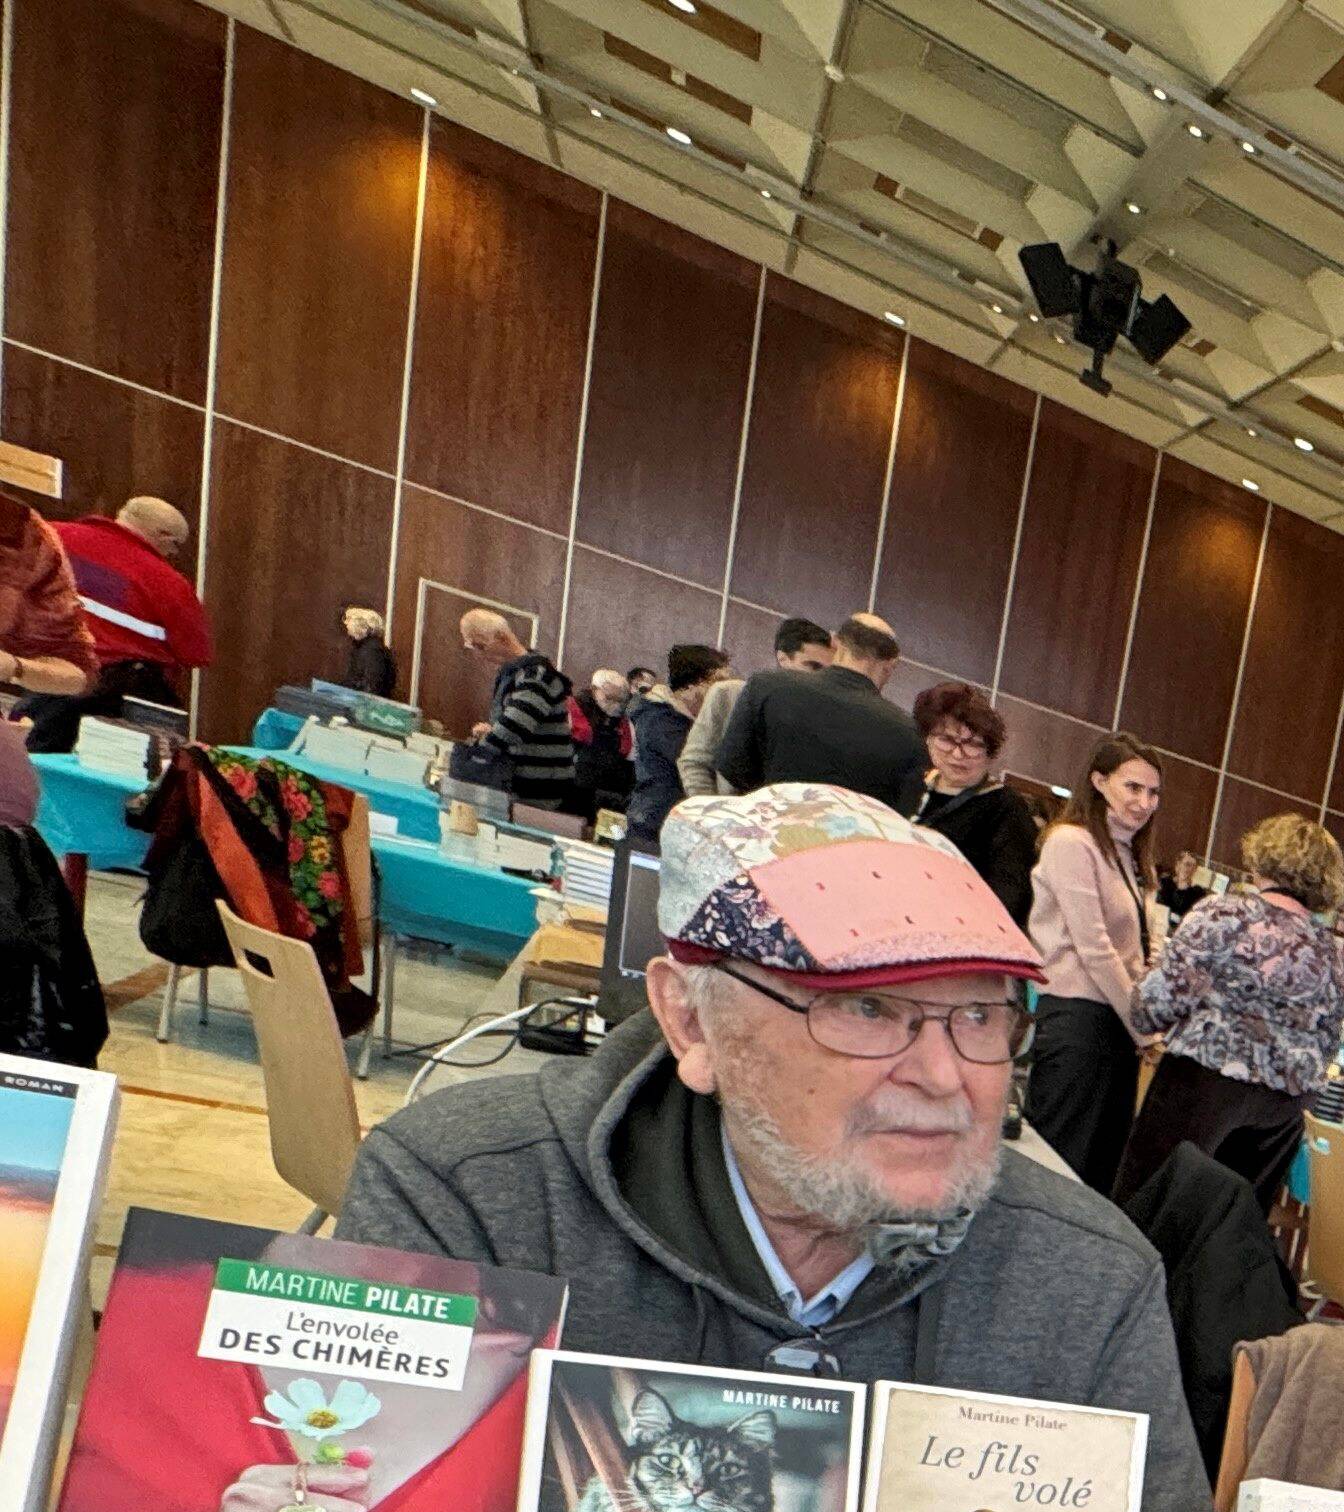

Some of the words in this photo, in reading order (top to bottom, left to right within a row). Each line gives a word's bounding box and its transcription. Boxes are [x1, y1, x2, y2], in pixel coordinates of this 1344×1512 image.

[4, 1076, 63, 1092] ROMAN
[245, 1267, 358, 1306] MARTINE
[365, 1286, 452, 1320] PILATE
[286, 1311, 400, 1347] L'envolée
[219, 1327, 284, 1358] DES
[292, 1337, 451, 1379] CHIMÈRES
[723, 1390, 788, 1410] MARTINE
[792, 1397, 840, 1414] PILATE
[958, 1406, 1020, 1427] Martine
[1025, 1414, 1068, 1432] Pilate
[919, 1436, 964, 1468] Le
[969, 1441, 1040, 1480] fils
[1014, 1478, 1093, 1509] volé
